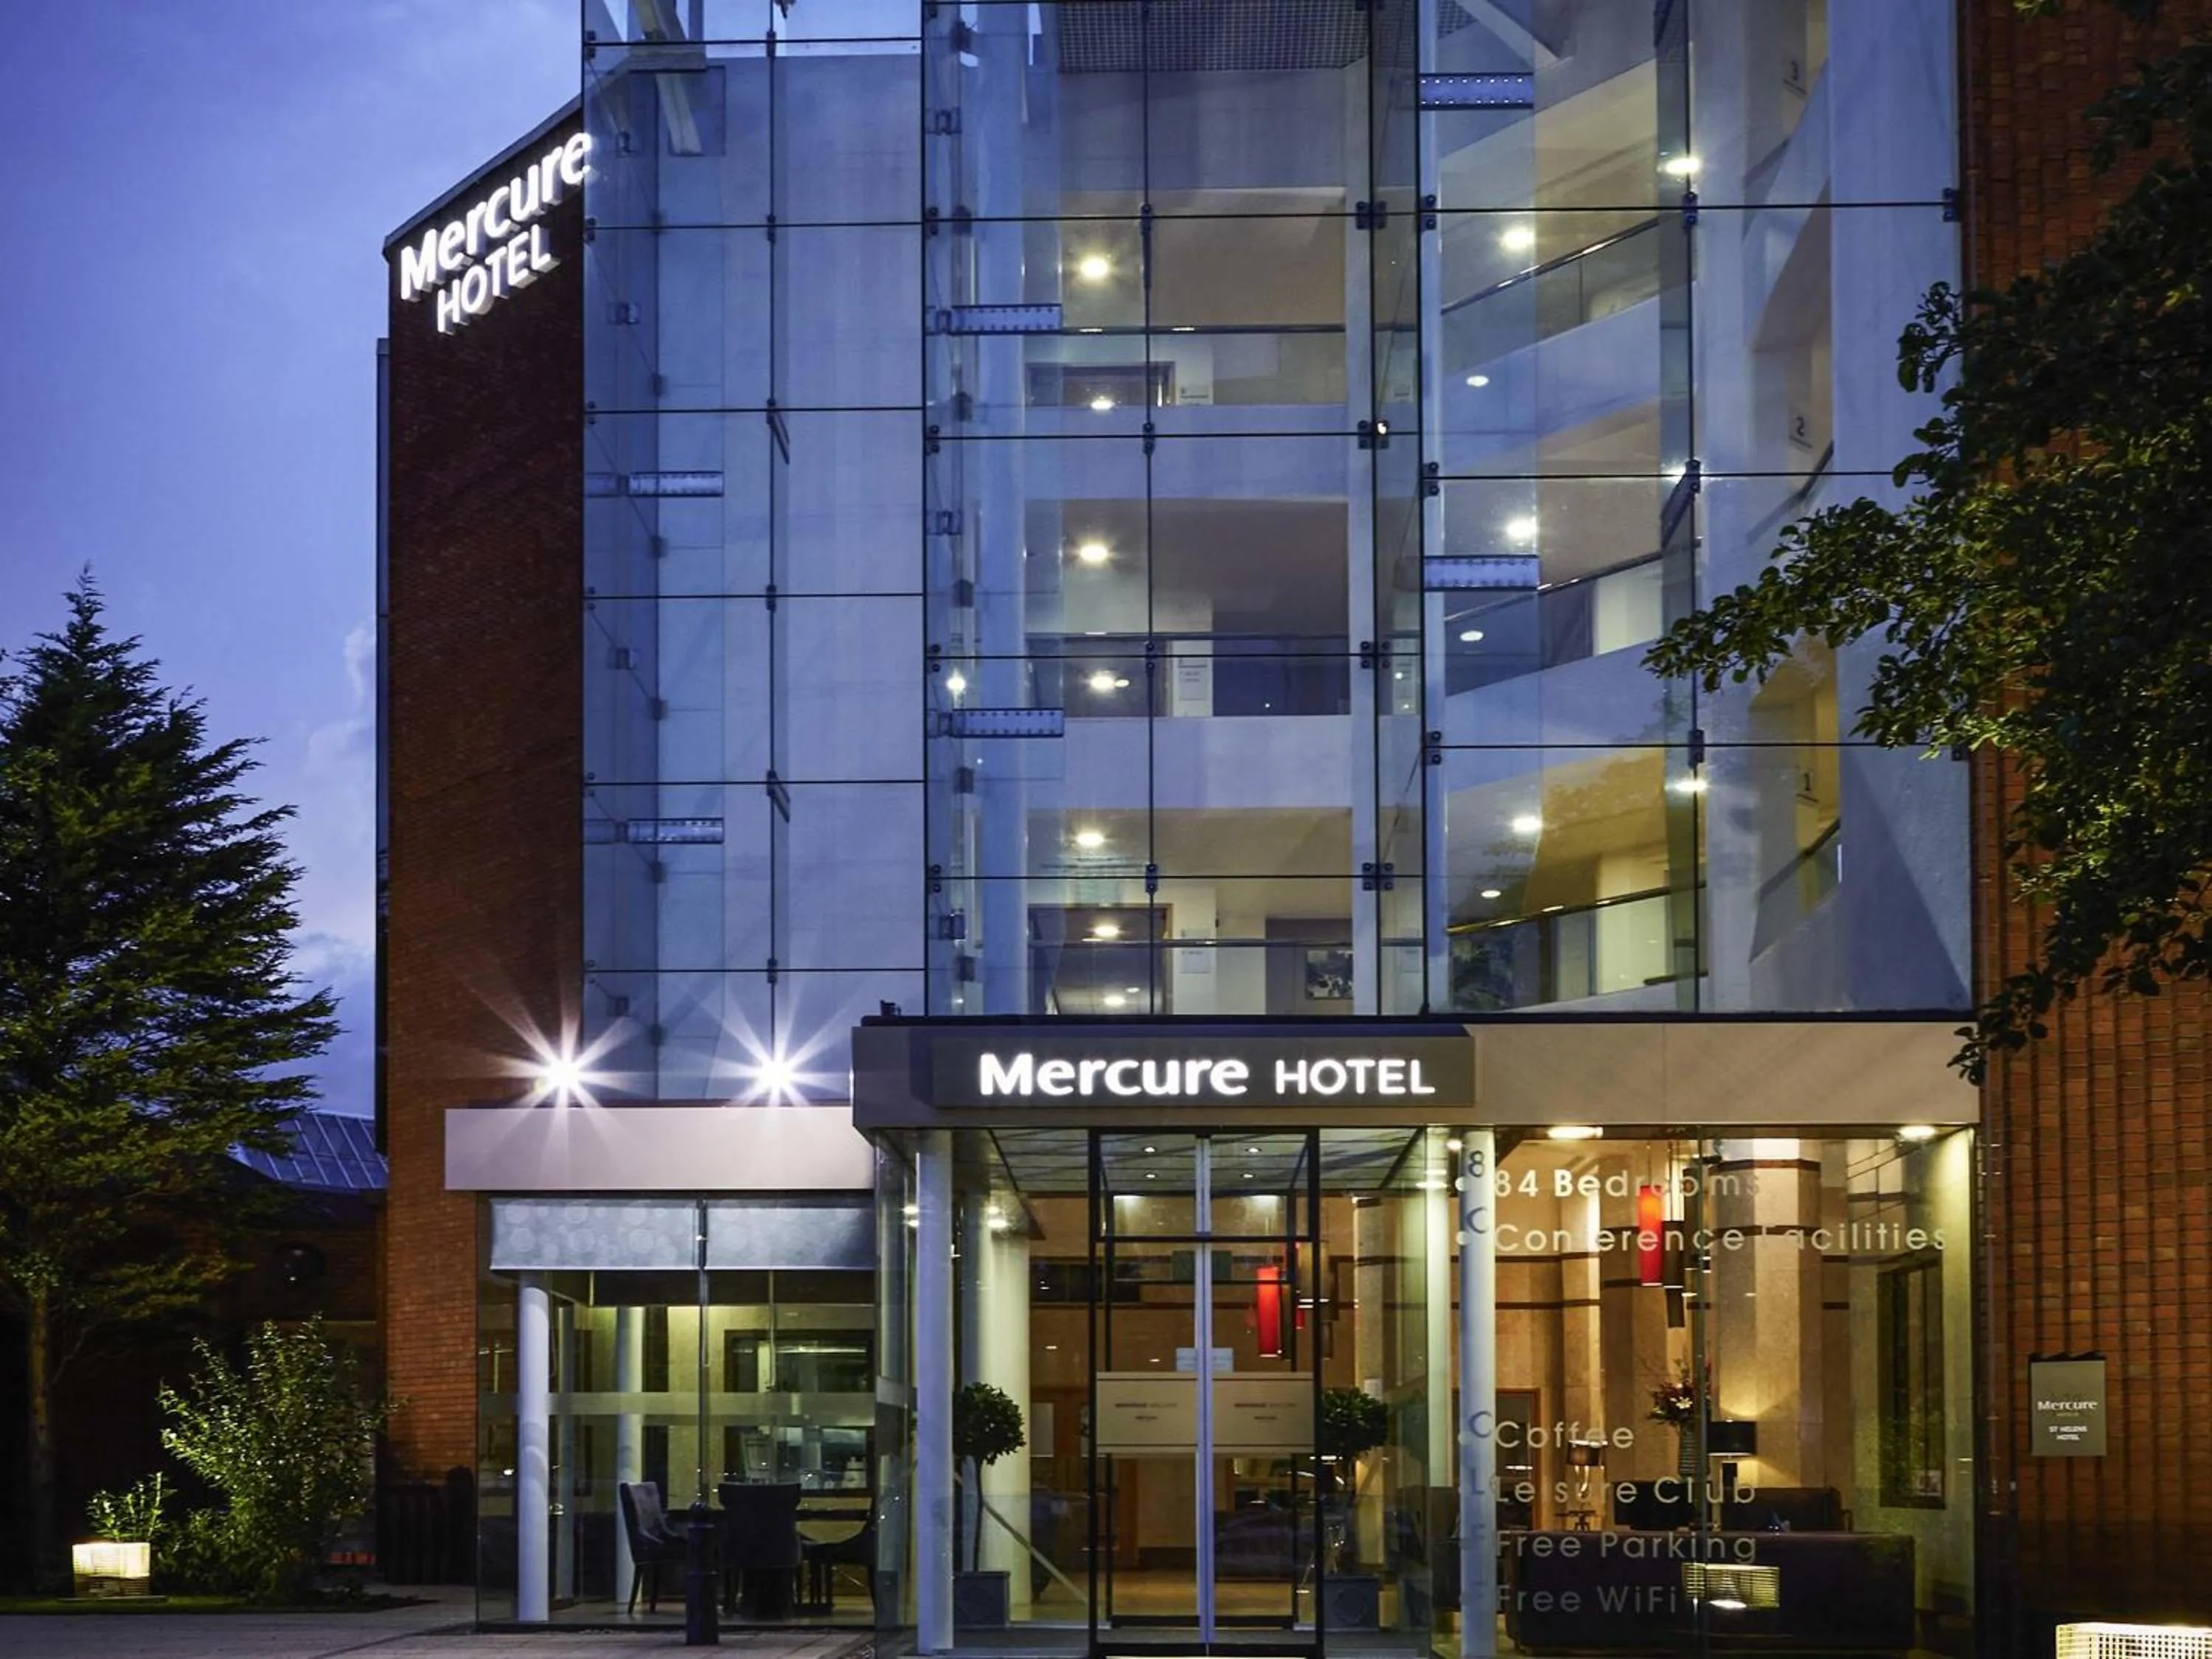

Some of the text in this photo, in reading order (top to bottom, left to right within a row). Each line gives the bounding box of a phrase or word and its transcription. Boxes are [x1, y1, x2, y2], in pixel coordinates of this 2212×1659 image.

[400, 131, 592, 302] Mercure
[437, 223, 554, 334] HOTEL
[979, 1052, 1436, 1096] Mercure HOTEL
[1495, 1169, 1539, 1197] 84
[1495, 1223, 1745, 1251] Conerence
[2037, 1400, 2098, 1411] Mercure
[1495, 1420, 1635, 1449] Coffee
[1495, 1475, 1756, 1504] Lesure Club
[1496, 1530, 1757, 1565] Free Parking
[1496, 1584, 1676, 1614] Free WiFi
